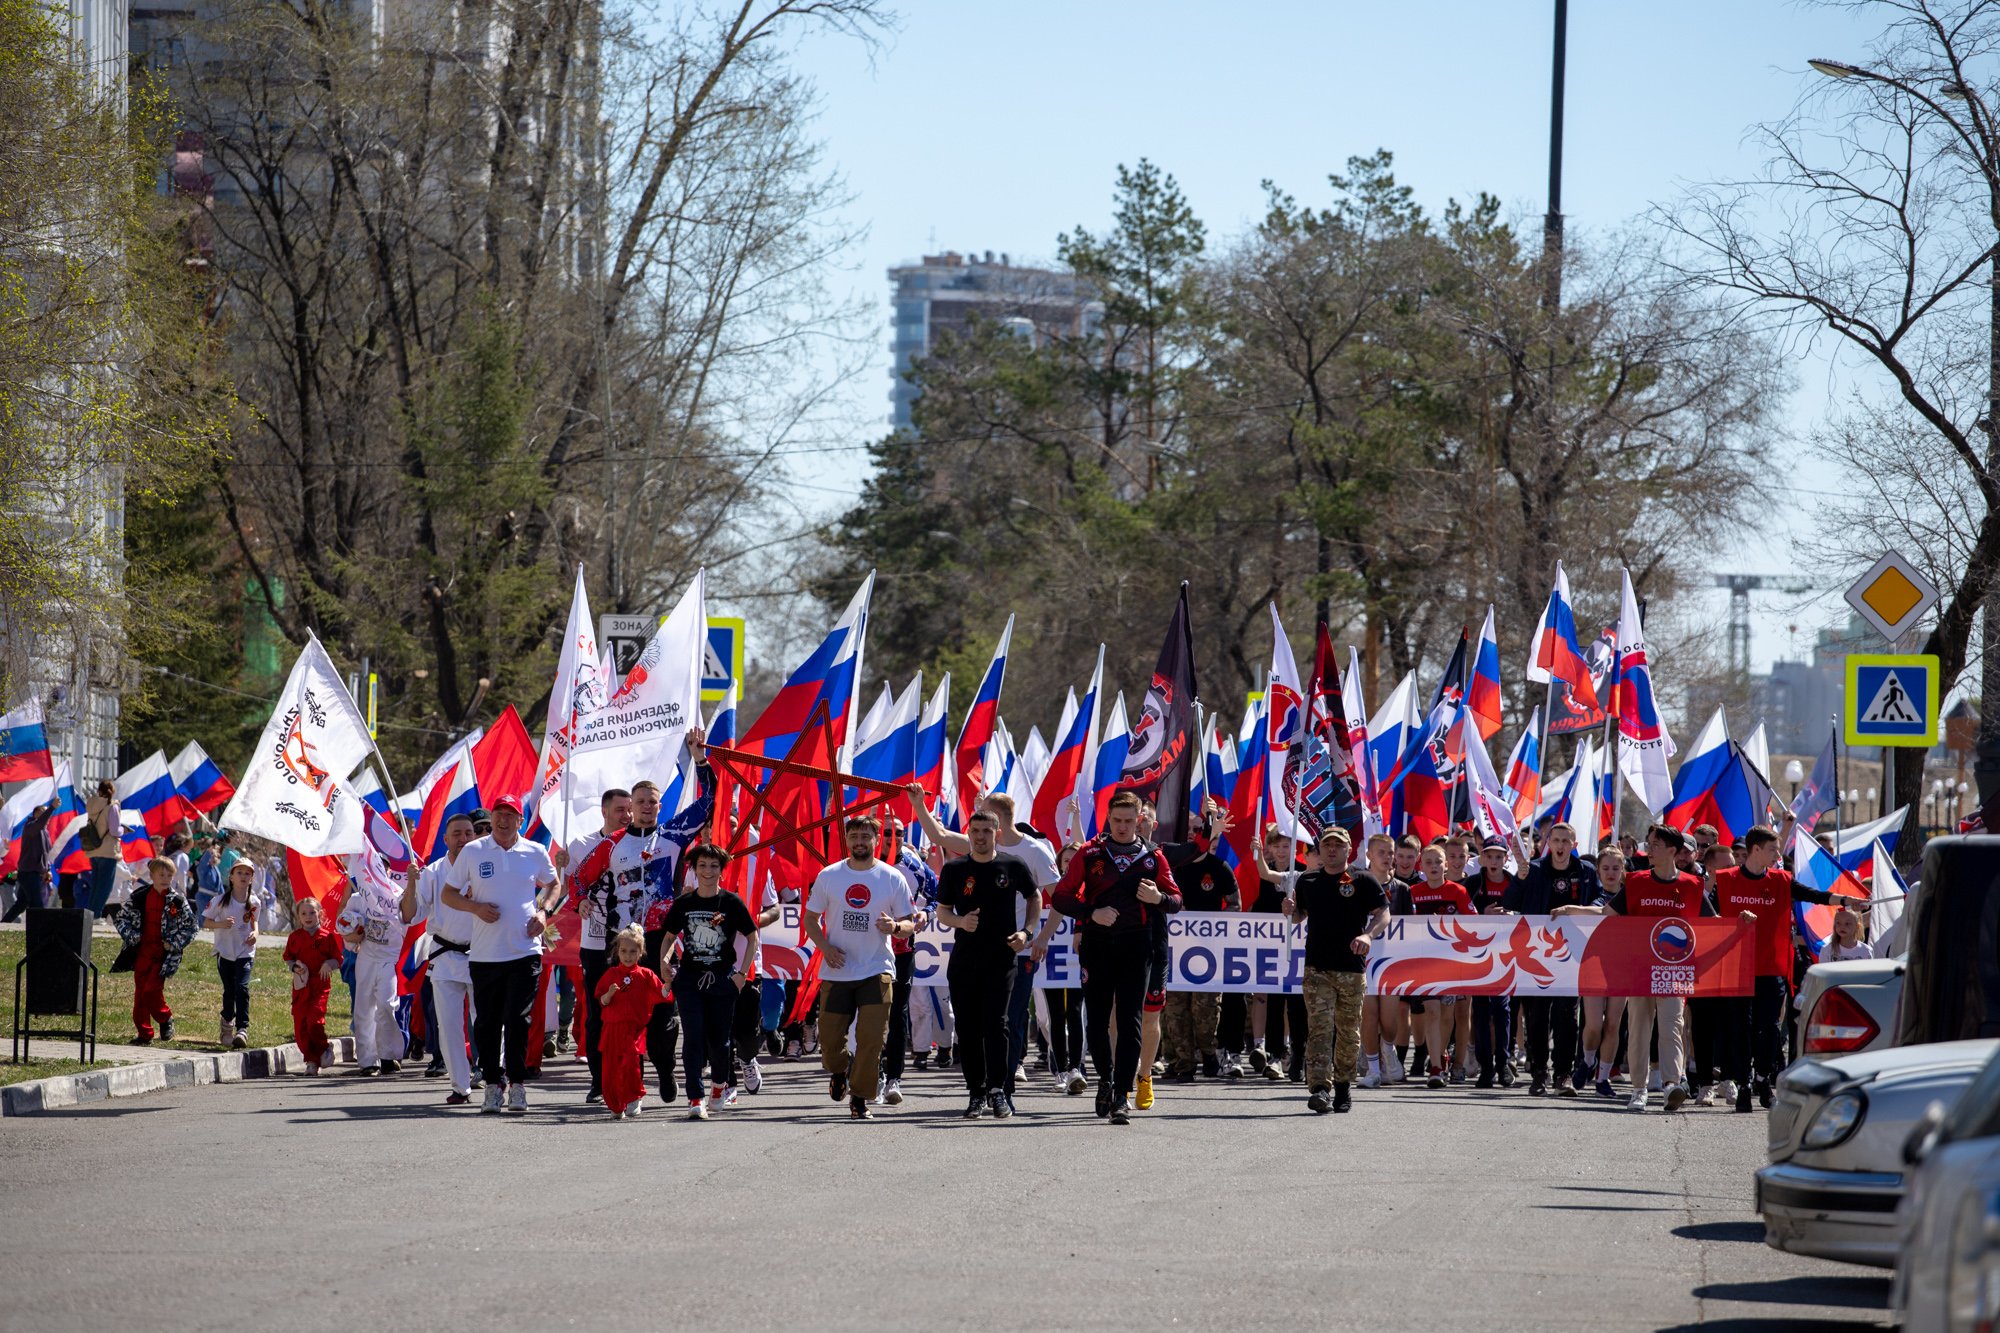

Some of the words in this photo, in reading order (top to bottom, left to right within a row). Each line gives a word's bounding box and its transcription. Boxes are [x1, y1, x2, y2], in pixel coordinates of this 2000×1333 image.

[612, 620, 643, 631] ЗОНА
[1620, 736, 1663, 750] КУССТВ
[843, 914, 870, 922] СОЮЗ
[1651, 971, 1695, 981] СОЮЗ
[1651, 981, 1695, 989] БОЕВЫХ
